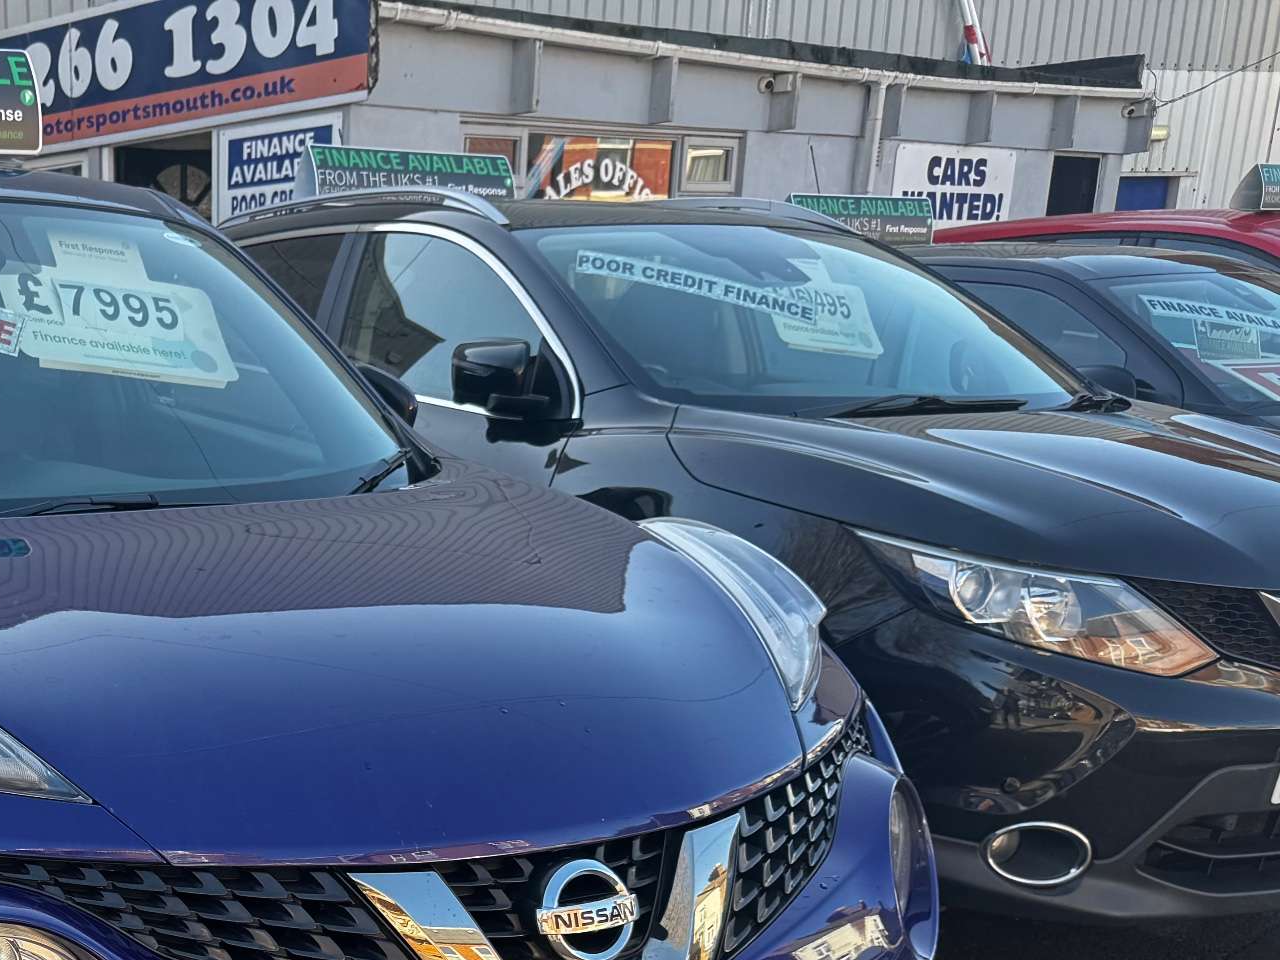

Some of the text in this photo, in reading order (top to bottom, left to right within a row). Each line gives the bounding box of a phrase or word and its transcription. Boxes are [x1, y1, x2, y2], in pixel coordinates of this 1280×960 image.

[164, 0, 339, 78] 1304
[242, 132, 315, 160] FINANCE
[314, 148, 510, 176] FINANCE AVAILABLE
[926, 155, 988, 187] CARS
[318, 169, 357, 186] FROM
[360, 171, 387, 187] THE
[426, 175, 439, 188] #1
[467, 184, 507, 196] Response
[860, 200, 932, 217] AVAILABLE
[902, 192, 1003, 221] ANTED!
[872, 218, 881, 231] #1
[886, 225, 928, 234] First Response
[577, 254, 813, 321] POOR CREDIT FINANCE
[1146, 299, 1224, 319] FINANCE
[31, 330, 88, 347] Finance
[89, 339, 152, 357] available
[151, 347, 187, 361] here!
[553, 900, 635, 930] NISSAN
